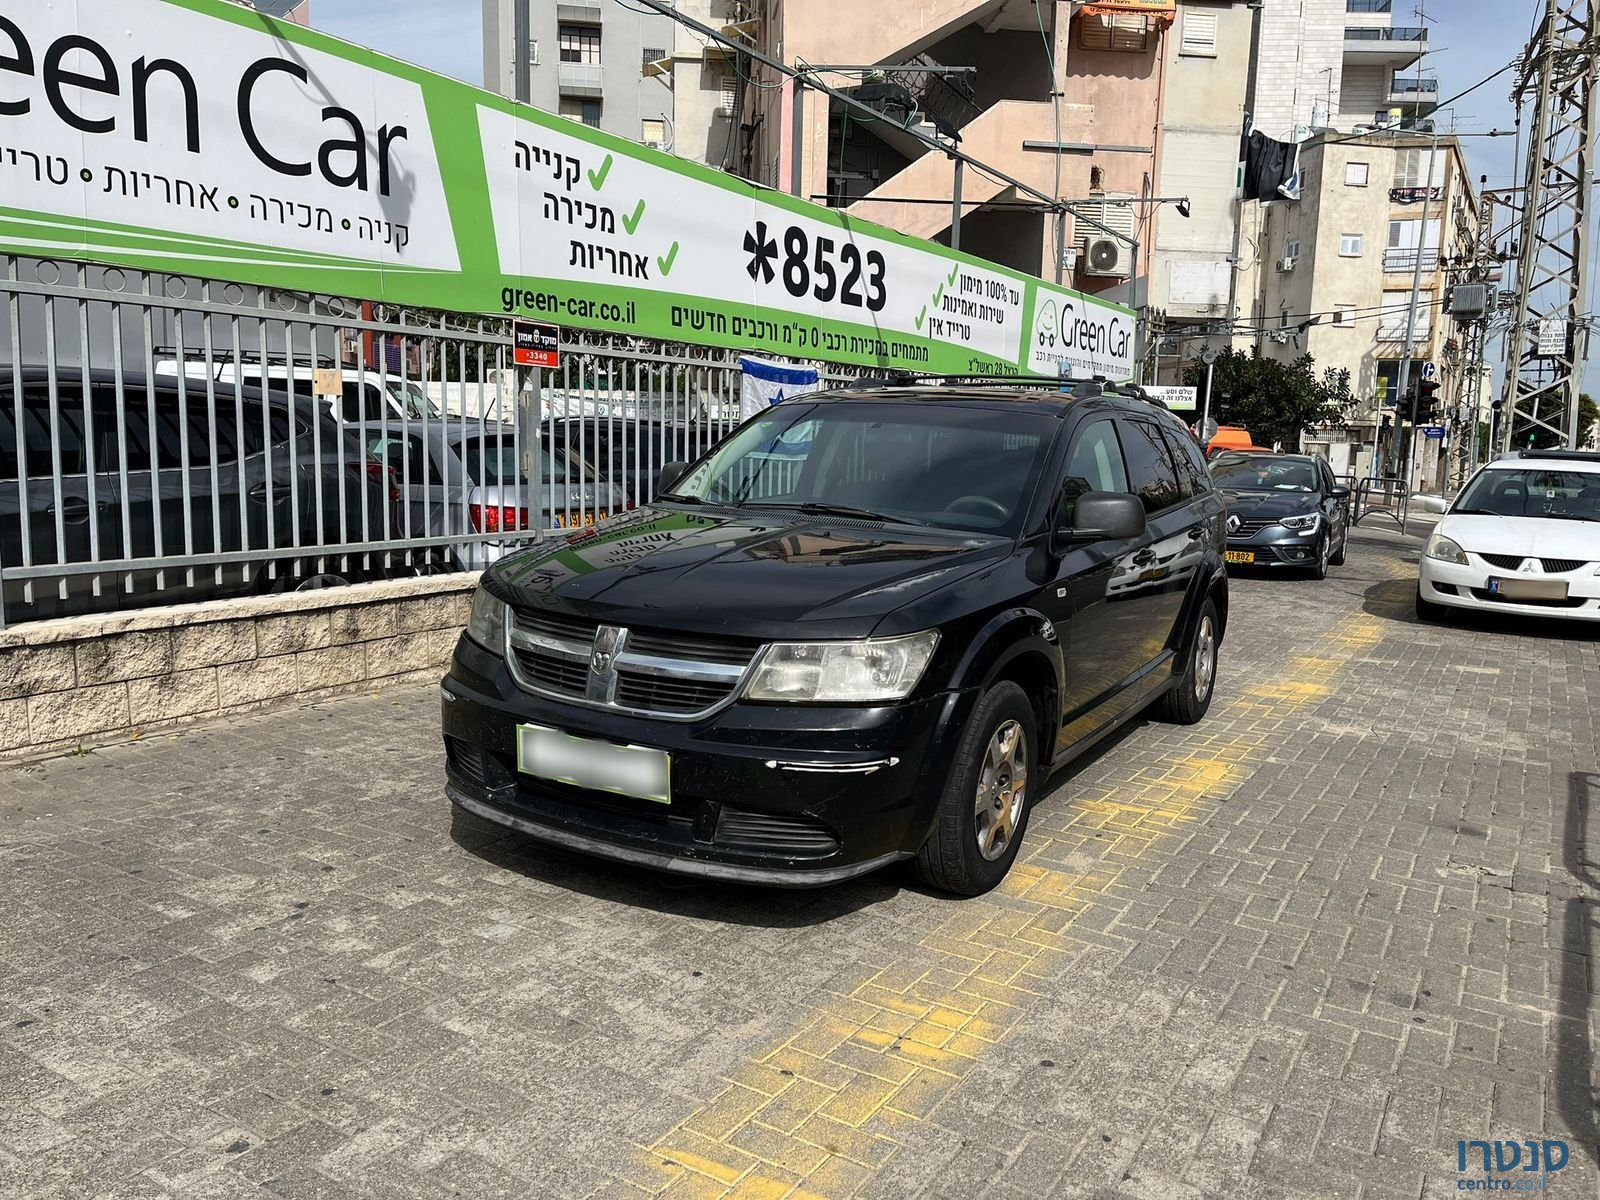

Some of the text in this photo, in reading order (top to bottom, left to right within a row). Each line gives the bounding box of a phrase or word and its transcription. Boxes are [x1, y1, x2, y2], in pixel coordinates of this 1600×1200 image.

[237, 56, 408, 197] Car
[514, 140, 581, 191] קנייה
[103, 166, 219, 212] אחריות
[249, 193, 333, 233] מכירה
[543, 191, 615, 234] מכירה
[358, 216, 409, 253] קניה
[569, 240, 649, 280] אחריות
[960, 273, 1020, 305] עד 100% מימון
[501, 286, 636, 324] green-car.co.il
[671, 305, 727, 334] חדשים
[942, 294, 1004, 324] שירות ואמינות
[517, 332, 533, 342] אמון
[540, 335, 557, 346] מוקד
[731, 316, 778, 342] ורכבים
[811, 327, 819, 348] 0
[822, 333, 848, 351] רכבי
[928, 316, 971, 340] טרייד אין
[1061, 303, 1131, 359] Green Car
[850, 336, 889, 357] במכירת
[891, 341, 929, 362] מתמחים
[1035, 351, 1046, 361] רכב
[994, 361, 1003, 375] 28
